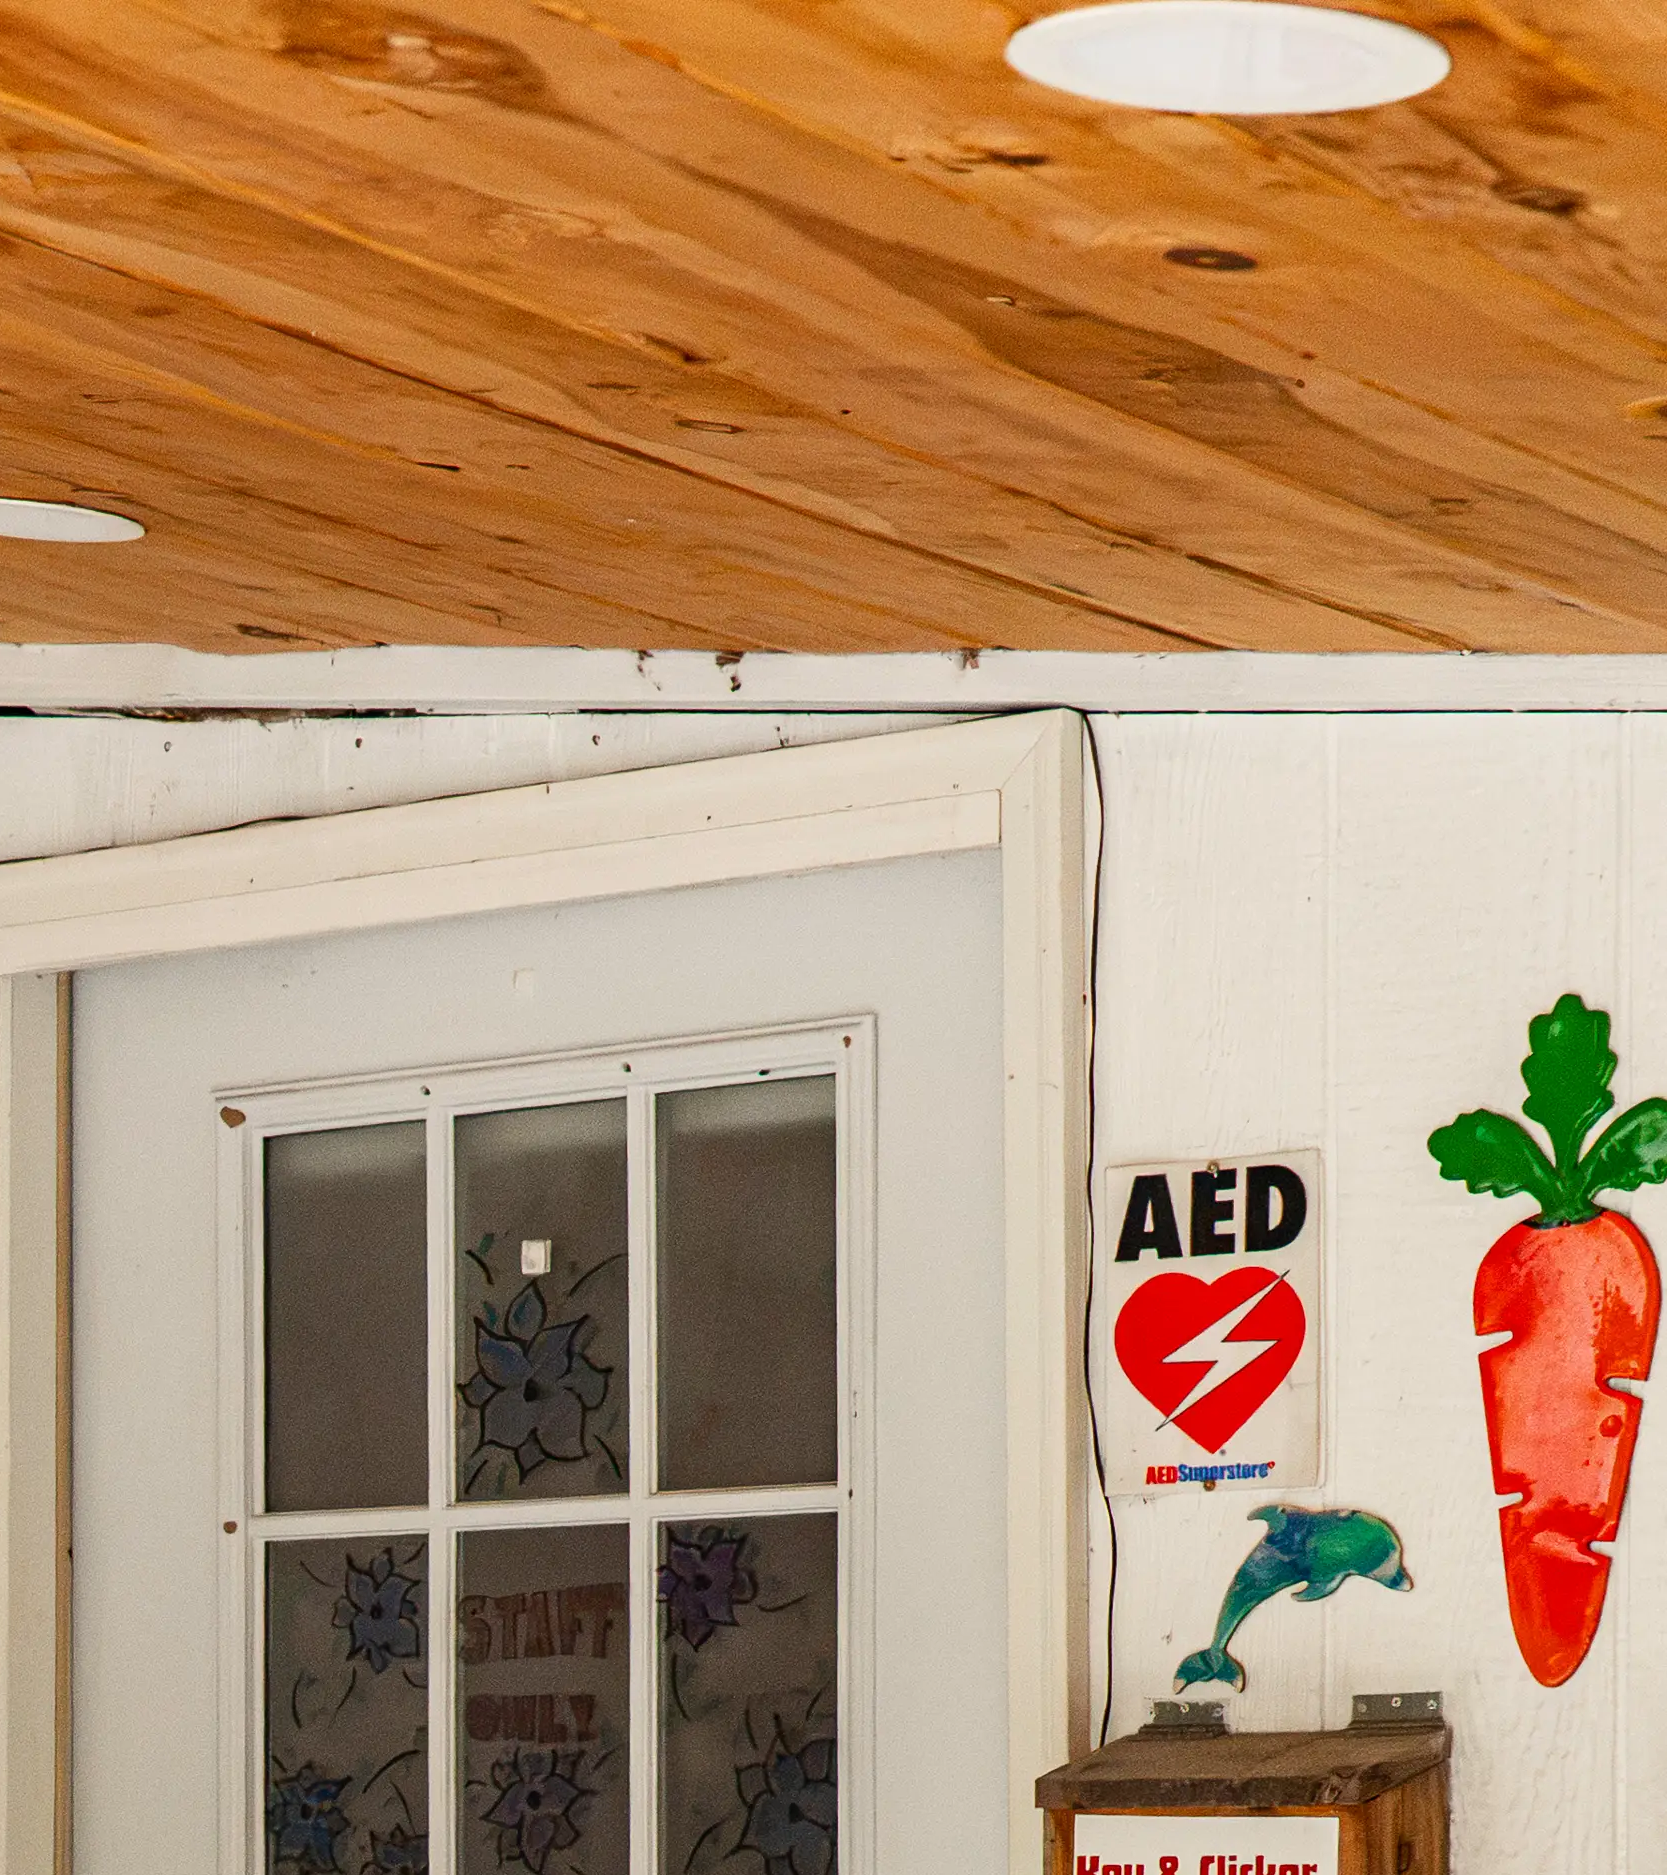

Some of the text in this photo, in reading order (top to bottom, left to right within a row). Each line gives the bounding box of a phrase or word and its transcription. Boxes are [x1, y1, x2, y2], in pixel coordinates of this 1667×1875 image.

[1113, 1165, 1308, 1263] AED
[457, 1582, 624, 1664] STAFF
[469, 1693, 597, 1742] ONLY
